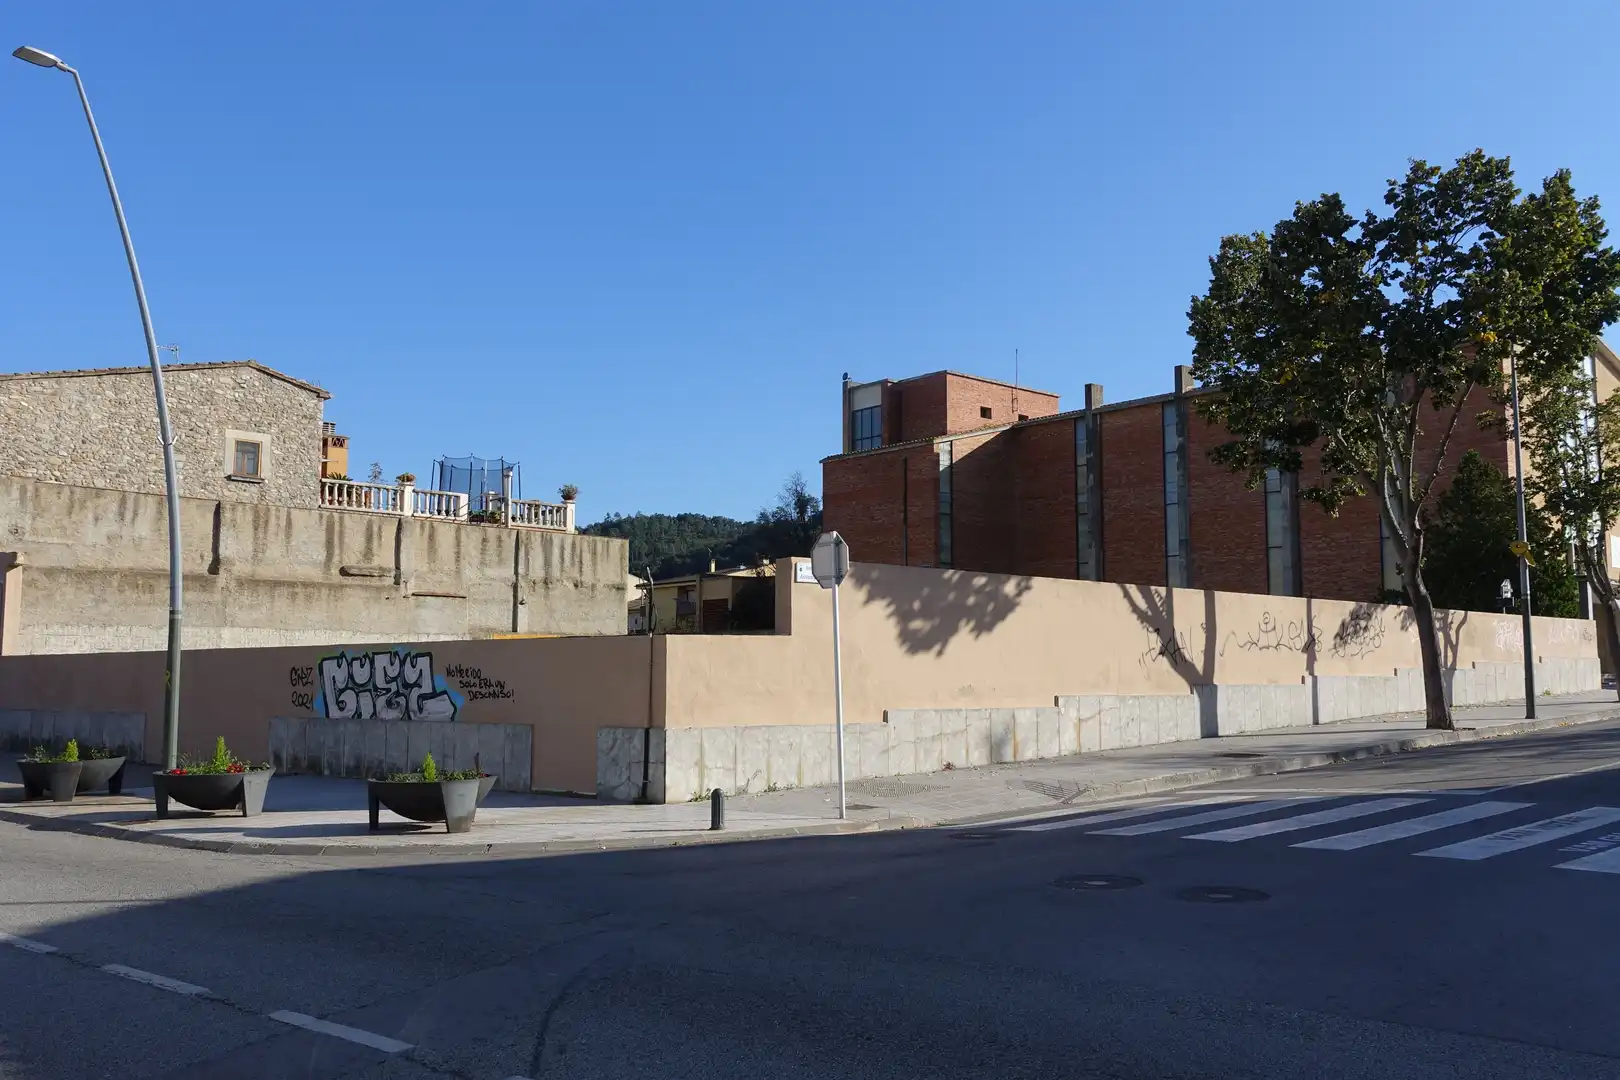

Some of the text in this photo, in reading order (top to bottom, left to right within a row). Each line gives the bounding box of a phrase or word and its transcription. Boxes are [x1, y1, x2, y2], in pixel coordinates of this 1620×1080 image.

[479, 678, 494, 689] ERA
[292, 690, 314, 710] 2021
[468, 689, 515, 703] DESCANSO!
